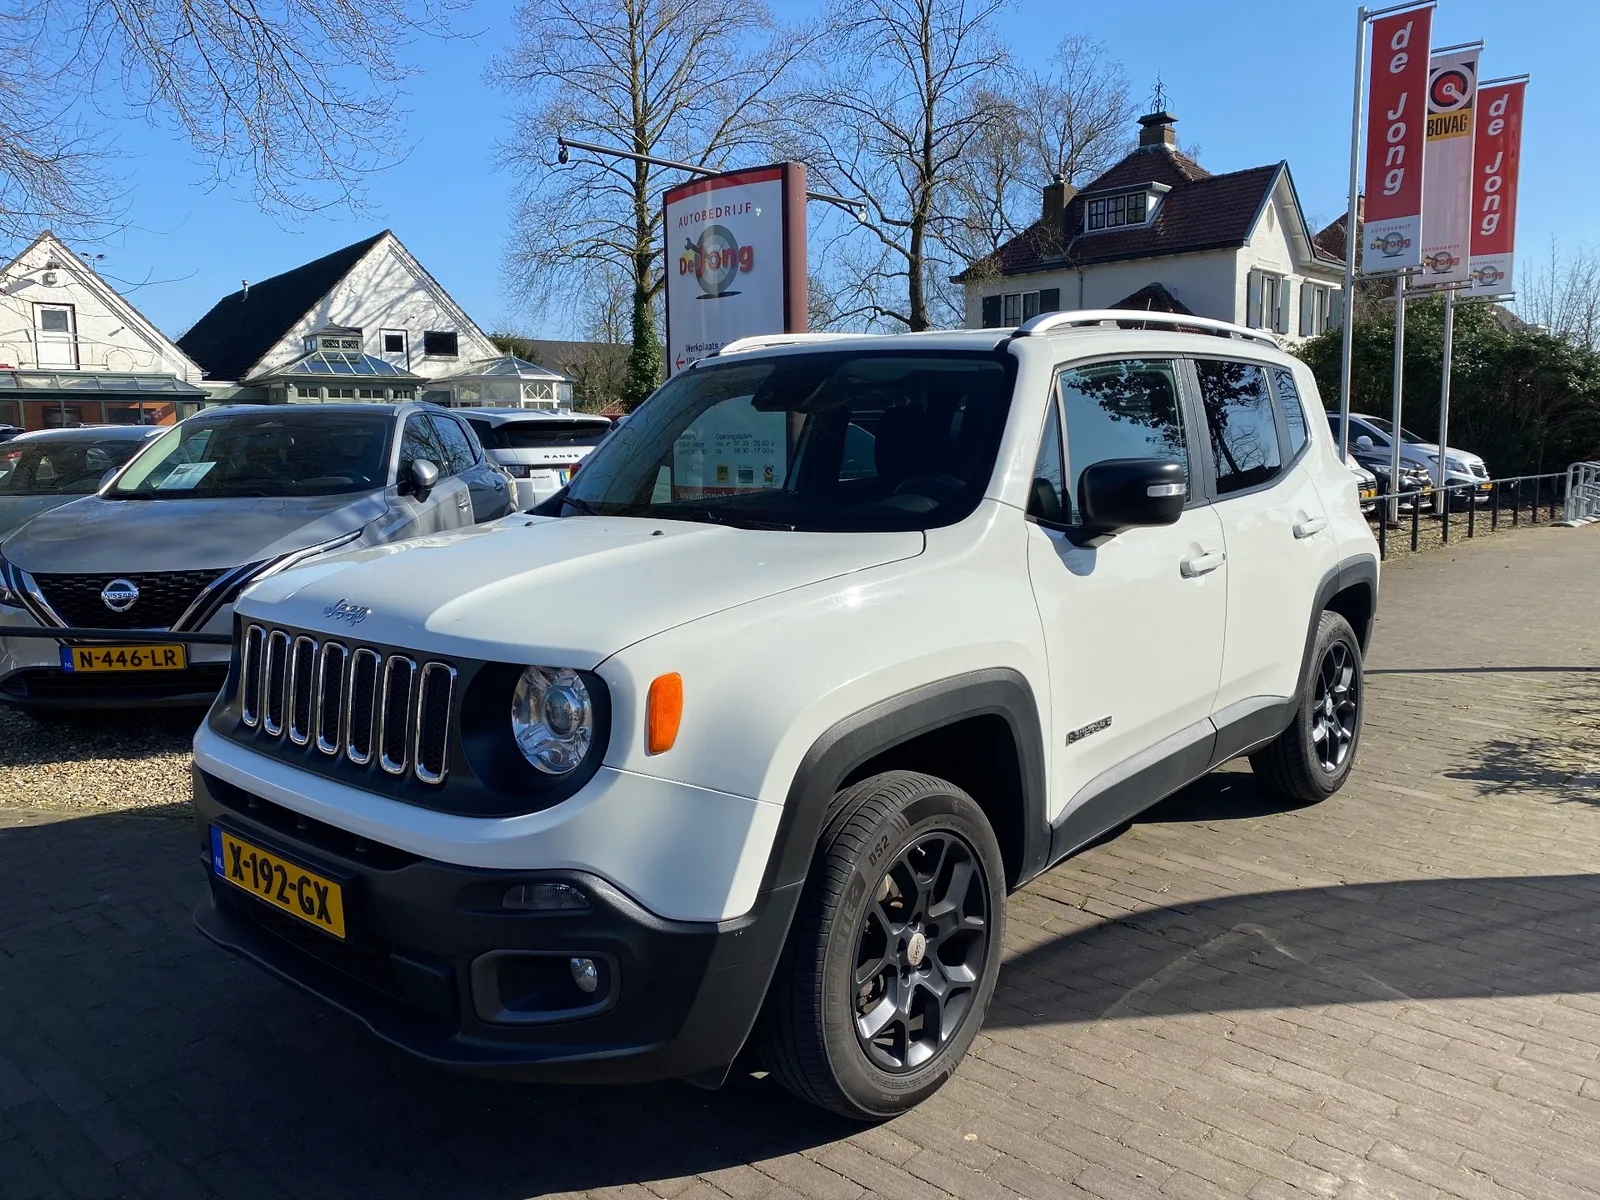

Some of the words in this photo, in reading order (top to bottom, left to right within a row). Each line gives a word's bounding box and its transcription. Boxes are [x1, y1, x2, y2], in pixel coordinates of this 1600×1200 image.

[1389, 21, 1413, 73] de
[1427, 113, 1468, 137] BOVAG
[1488, 94, 1509, 135] de
[1383, 92, 1408, 196] Jong
[1481, 152, 1503, 235] Jong
[678, 202, 752, 228] AUTOBEDRIJF
[1371, 224, 1411, 233] AUTOBEDRIJF
[679, 256, 694, 275] De
[696, 245, 753, 276] Jong
[685, 342, 719, 353] Werkplaats
[715, 433, 753, 441] Openingstijden
[323, 598, 371, 627] Jeep
[79, 649, 177, 668] N-446-LR
[215, 855, 224, 869] NL
[228, 841, 332, 925] X-192-GX
